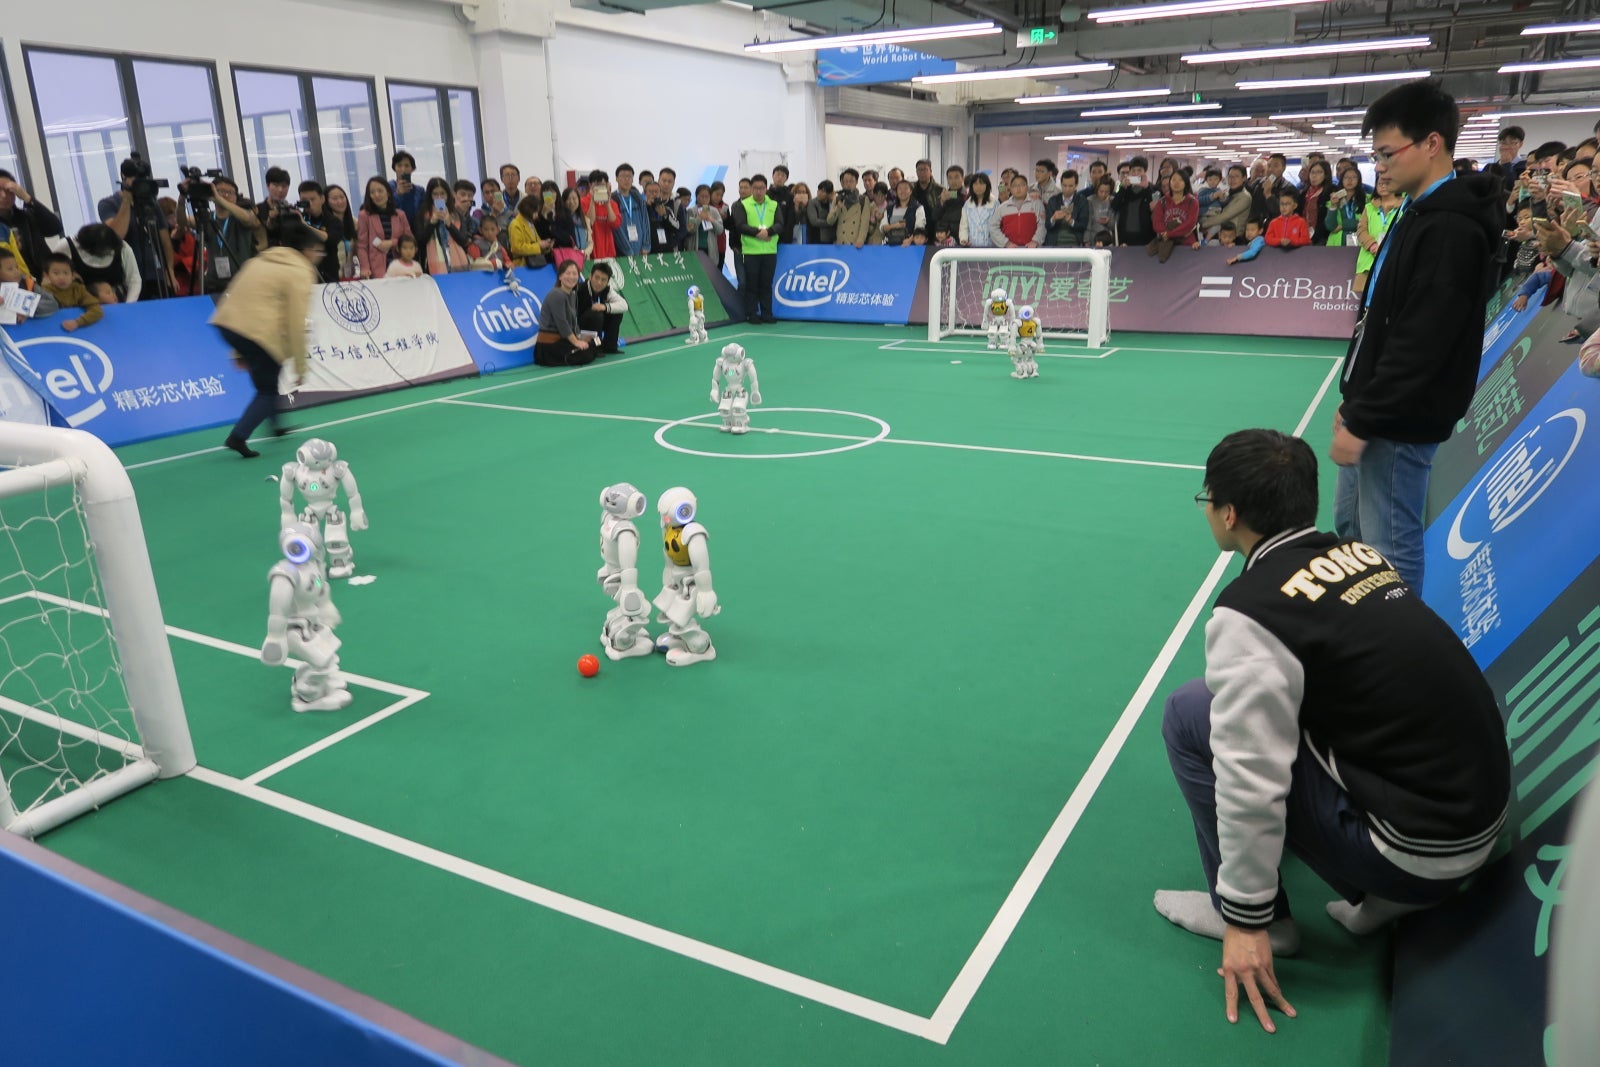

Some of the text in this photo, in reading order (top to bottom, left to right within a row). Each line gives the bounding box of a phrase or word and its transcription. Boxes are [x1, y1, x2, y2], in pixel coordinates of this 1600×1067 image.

[862, 55, 888, 66] World
[891, 52, 917, 63] Robot
[785, 269, 837, 293] intel
[1238, 275, 1361, 301] SoftBank
[835, 292, 894, 307] 精彩芯体验
[1312, 301, 1360, 312] Robotics
[476, 297, 540, 334] intel
[305, 329, 440, 362] 子与信息工程学院
[112, 376, 226, 412] 精彩芯体验
[1486, 425, 1554, 534] intel
[1280, 541, 1393, 602] TONG
